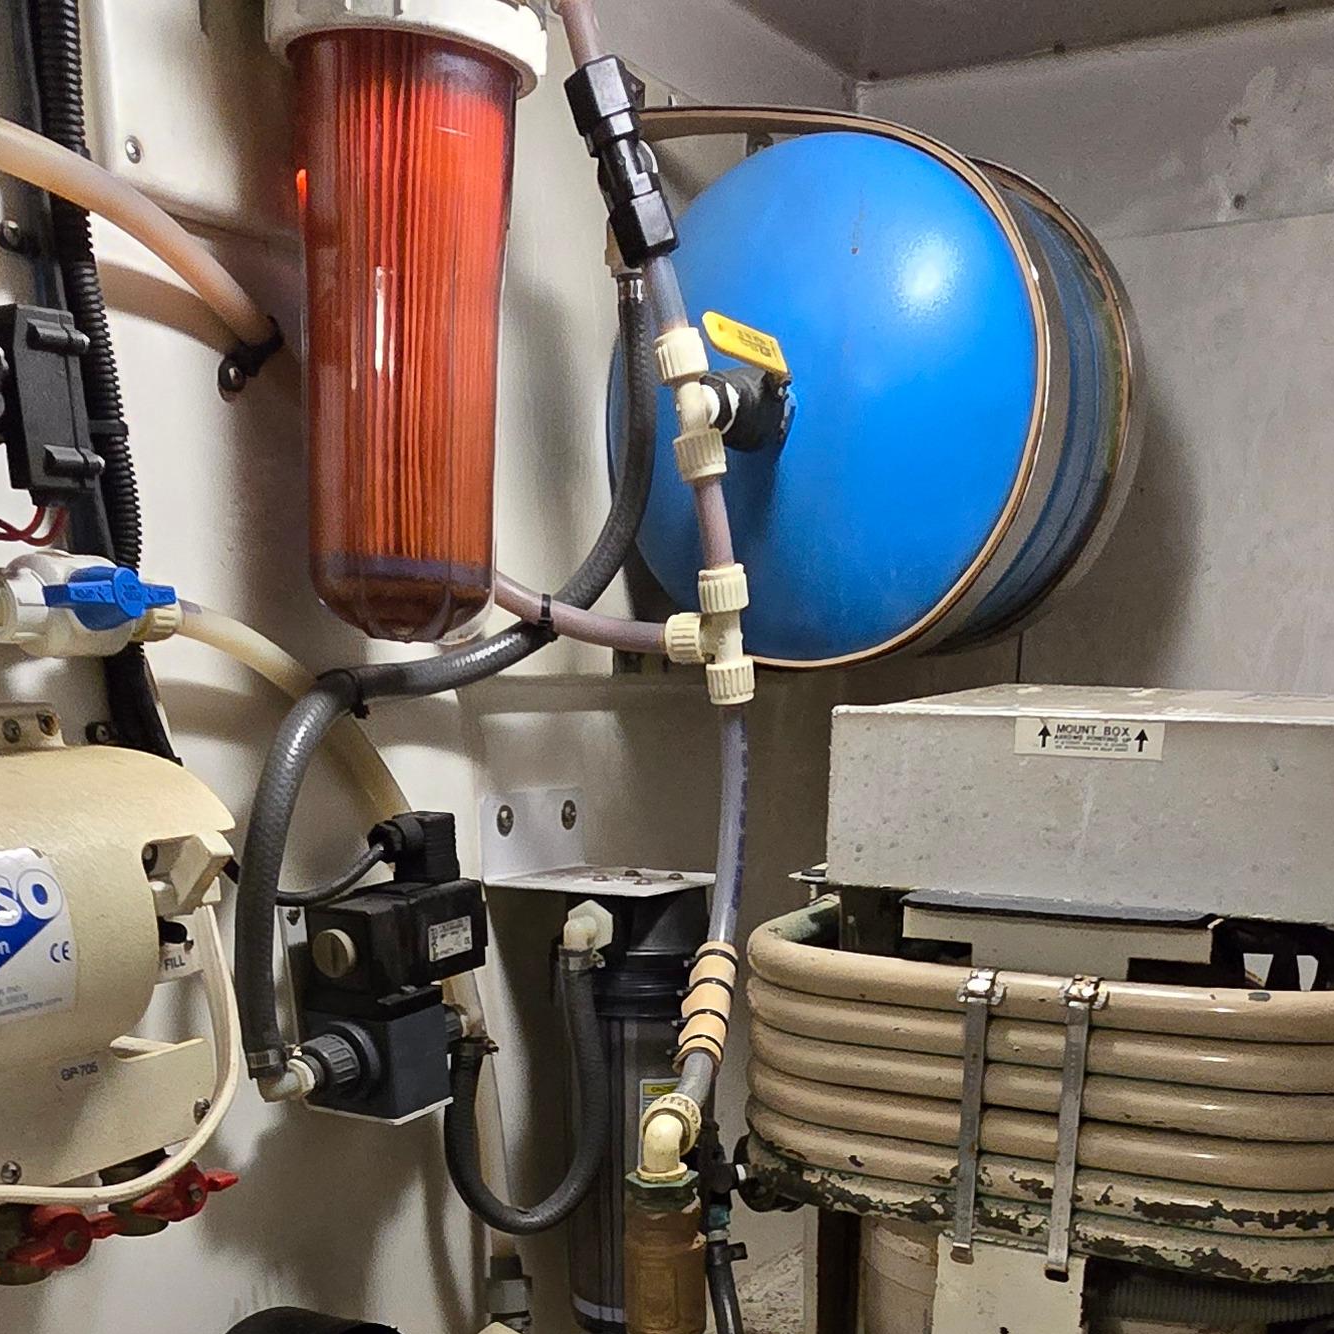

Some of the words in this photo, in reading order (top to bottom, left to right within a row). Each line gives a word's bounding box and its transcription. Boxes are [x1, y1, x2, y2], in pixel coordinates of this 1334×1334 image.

[1056, 724, 1097, 735] MOUNT
[1103, 726, 1130, 737] BOX
[163, 954, 186, 971] FILL
